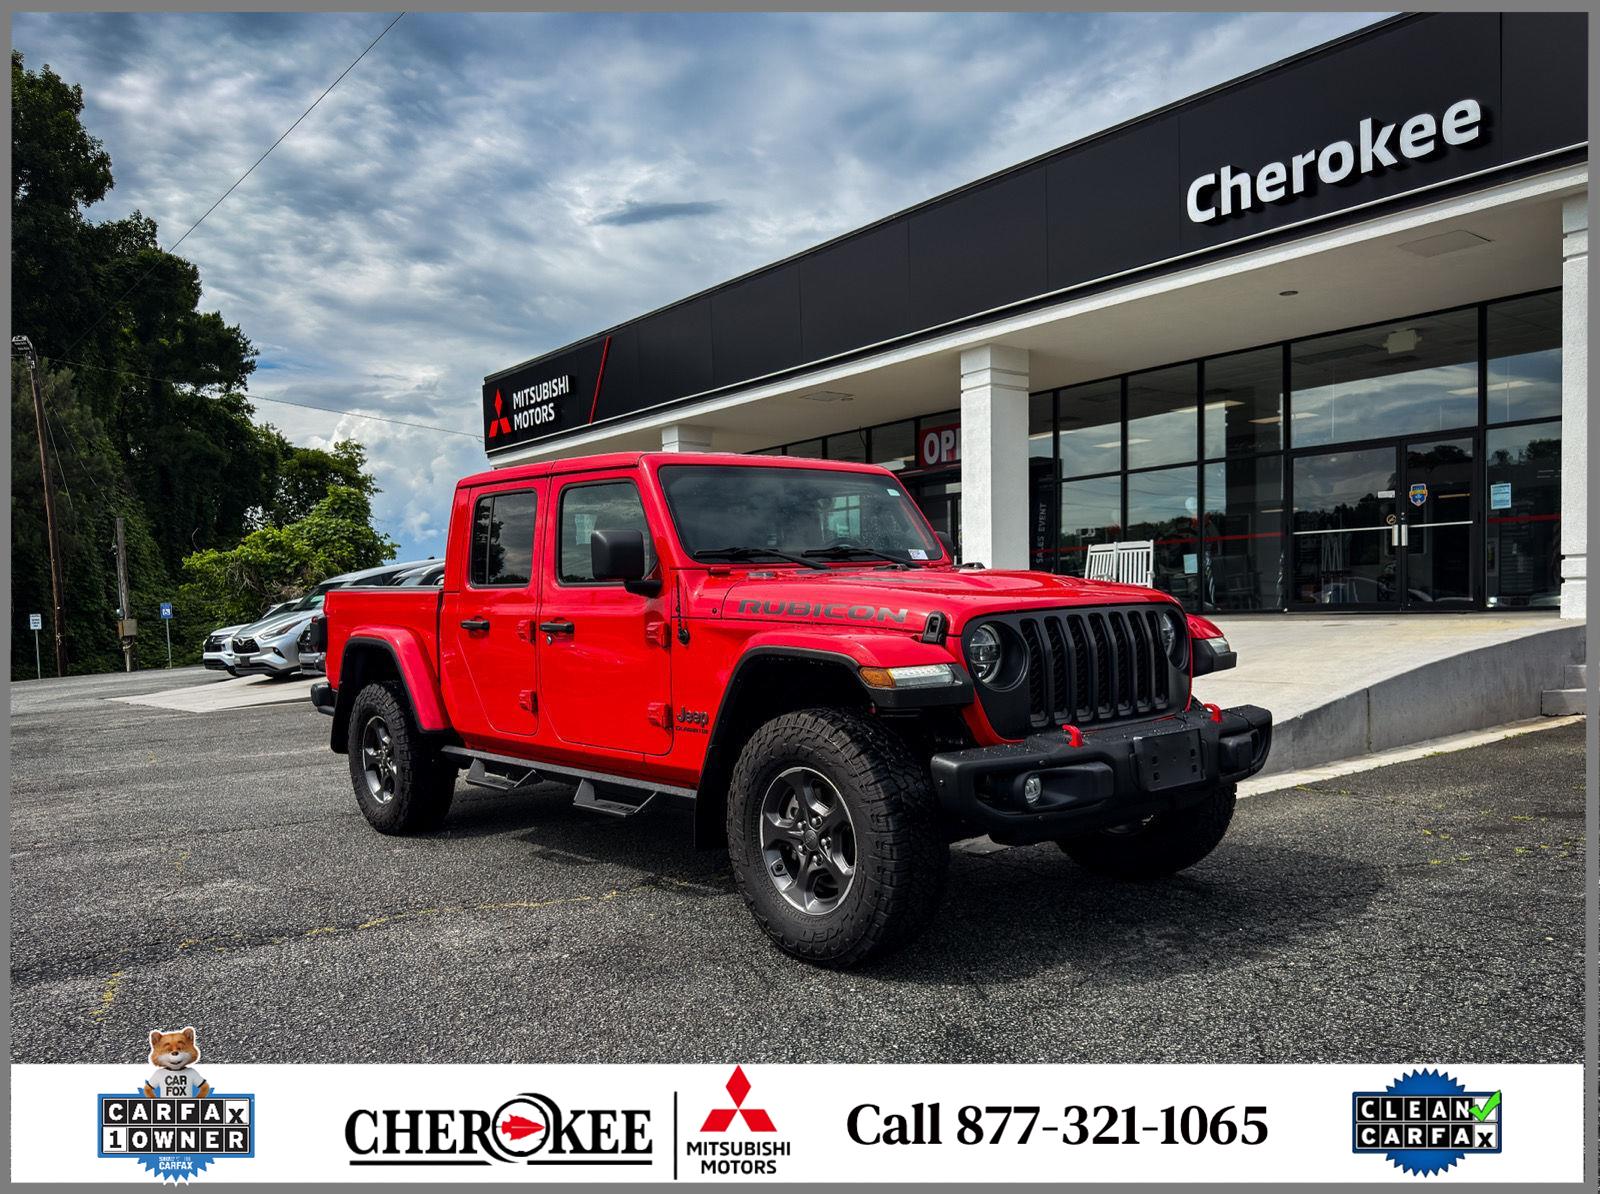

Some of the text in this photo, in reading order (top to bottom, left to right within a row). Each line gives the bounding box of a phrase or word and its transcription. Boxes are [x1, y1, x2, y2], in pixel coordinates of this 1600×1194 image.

[1186, 99, 1481, 223] Cherokee
[513, 375, 569, 410] MITSUBISHI
[513, 403, 555, 431] MOTORS
[1038, 503, 1047, 532] EVENT
[738, 599, 908, 623] RUBICON
[677, 706, 709, 729] Jeep
